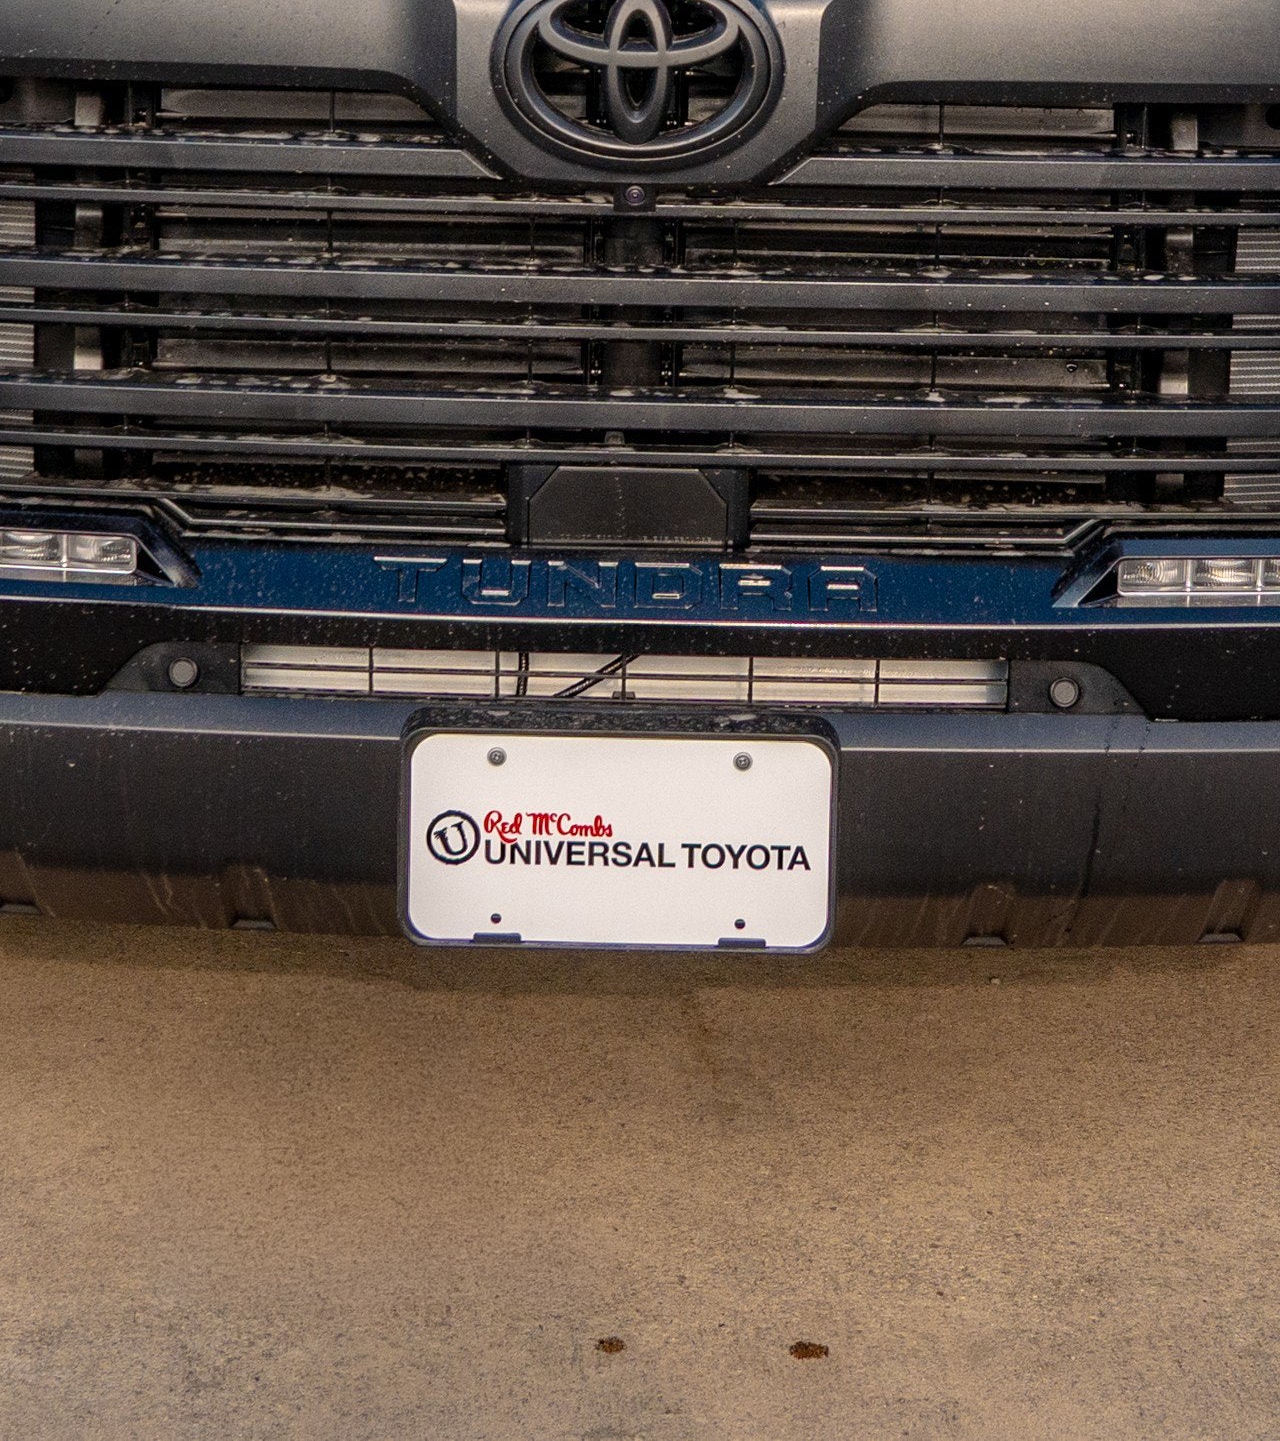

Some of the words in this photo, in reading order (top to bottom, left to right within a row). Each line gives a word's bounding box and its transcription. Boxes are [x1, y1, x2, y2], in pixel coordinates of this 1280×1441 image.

[374, 556, 878, 613] TUNDRA
[483, 809, 523, 844] Red
[526, 810, 613, 838] McCombs
[484, 839, 677, 869] UNIVERSAL
[682, 842, 812, 871] TOYOTA
